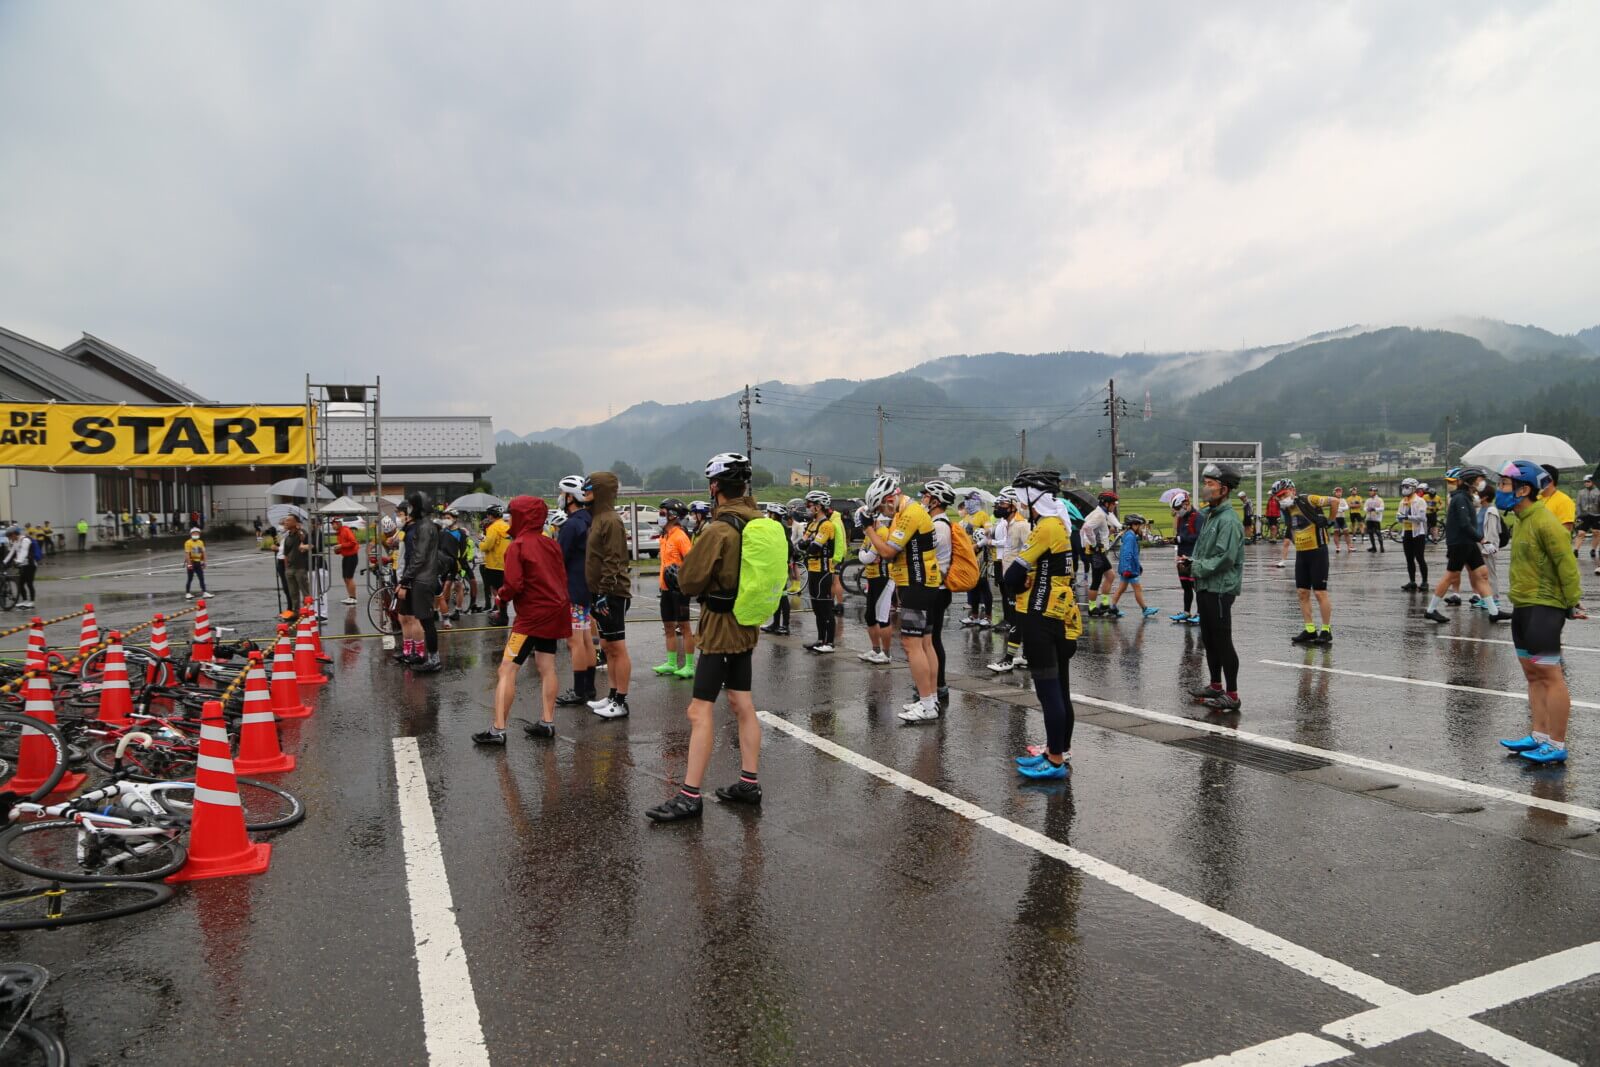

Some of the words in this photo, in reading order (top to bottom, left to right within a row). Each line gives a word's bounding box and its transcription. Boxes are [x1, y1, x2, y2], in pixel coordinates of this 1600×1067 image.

[10, 411, 47, 427] DE
[0, 429, 47, 445] ARI
[69, 416, 304, 454] START
[1040, 560, 1049, 577] TOUR
[1040, 577, 1047, 585] DE
